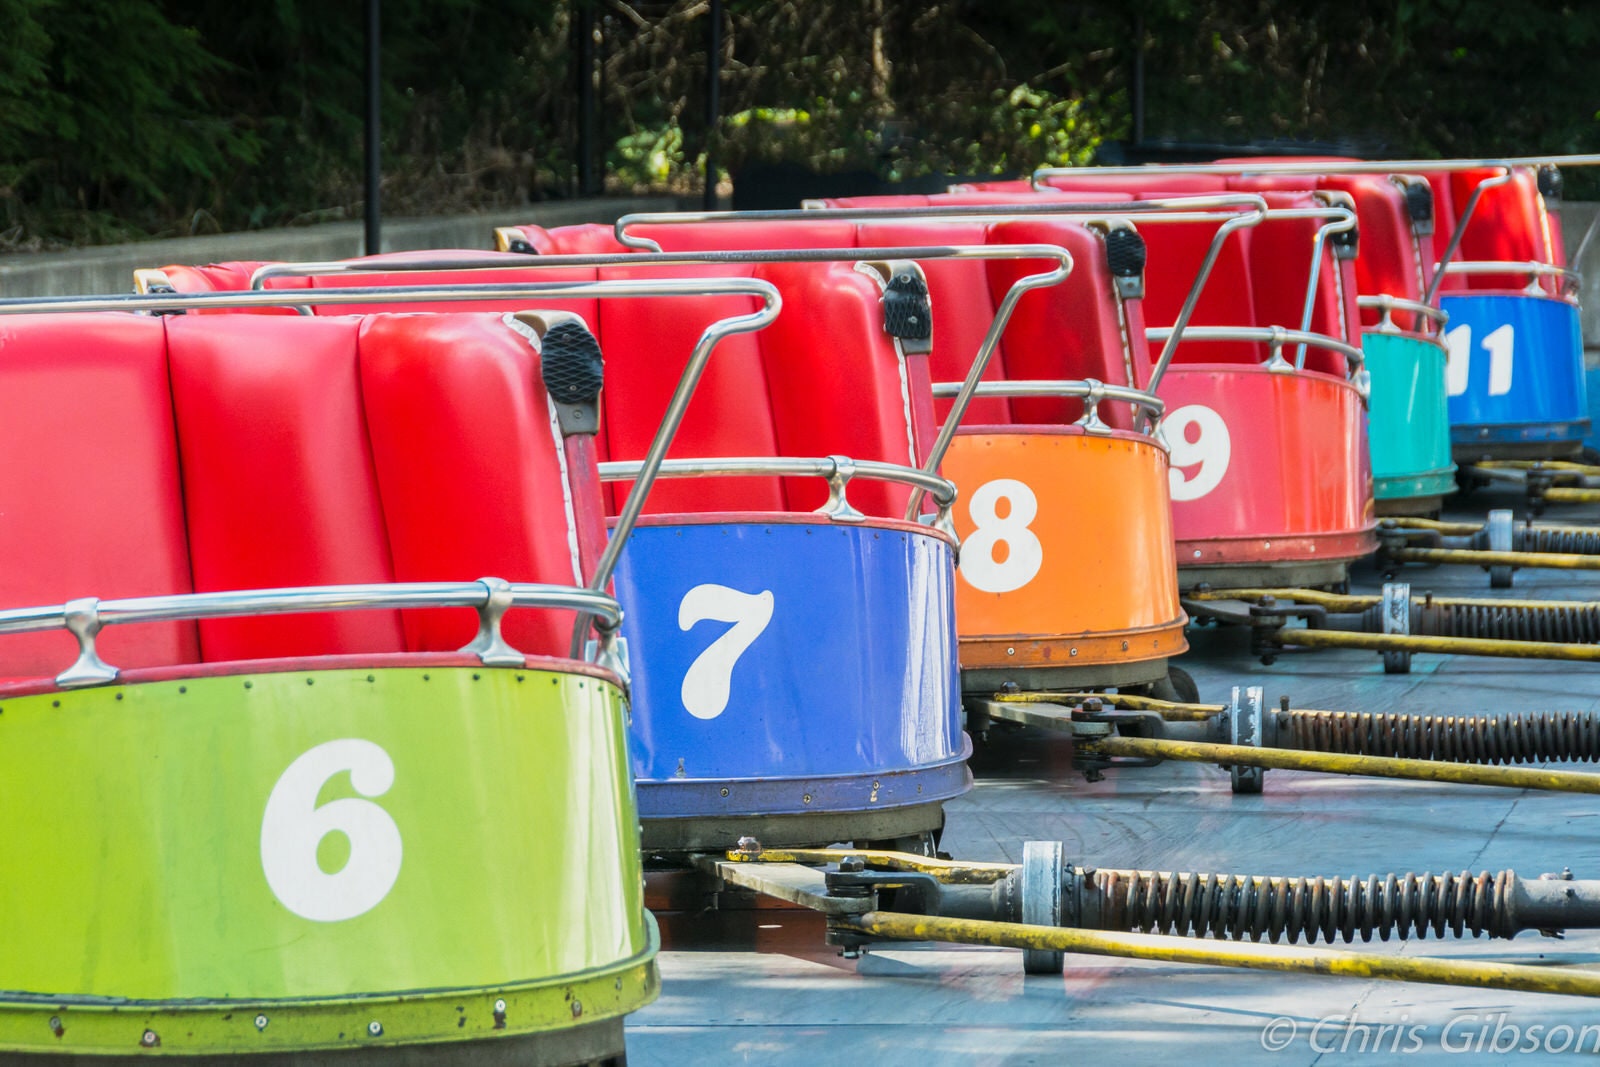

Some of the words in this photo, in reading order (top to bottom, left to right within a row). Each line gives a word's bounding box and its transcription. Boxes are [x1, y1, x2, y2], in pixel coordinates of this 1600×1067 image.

[1446, 324, 1514, 396] 11
[1162, 404, 1231, 501] 9
[960, 478, 1043, 592] 8
[678, 583, 775, 720] 7
[260, 738, 403, 923] 6
